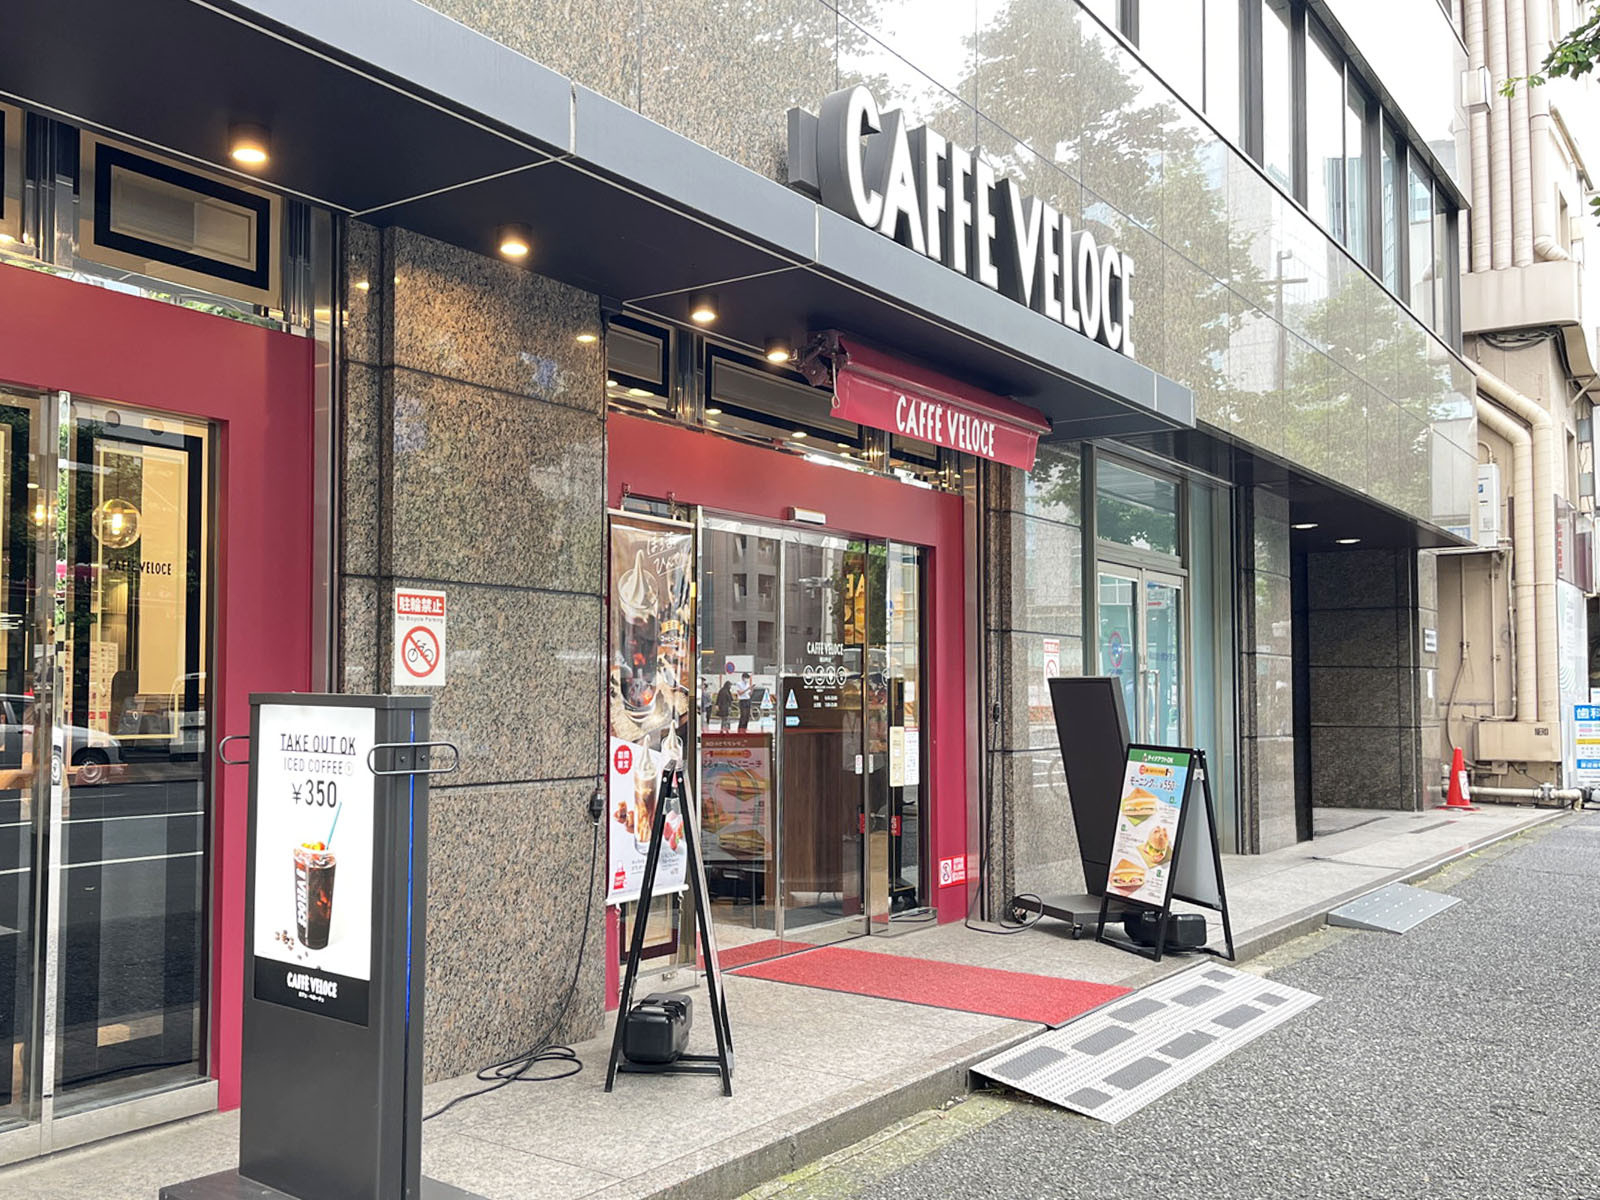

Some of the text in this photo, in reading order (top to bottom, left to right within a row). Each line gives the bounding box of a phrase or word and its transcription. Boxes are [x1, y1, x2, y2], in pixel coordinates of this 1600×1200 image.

[1008, 177, 1136, 359] VELOCE
[895, 395, 996, 457] CAFFÈ VELOCE
[141, 561, 172, 575] VELOCE
[400, 596, 443, 613] 駐輪禁止
[281, 733, 356, 754] TAKE OUT OK
[284, 757, 305, 772] ICED
[308, 759, 343, 775] COFFEE
[1130, 775, 1154, 788] モーニング
[291, 779, 337, 808] ¥350
[310, 976, 338, 998] VELOCE
